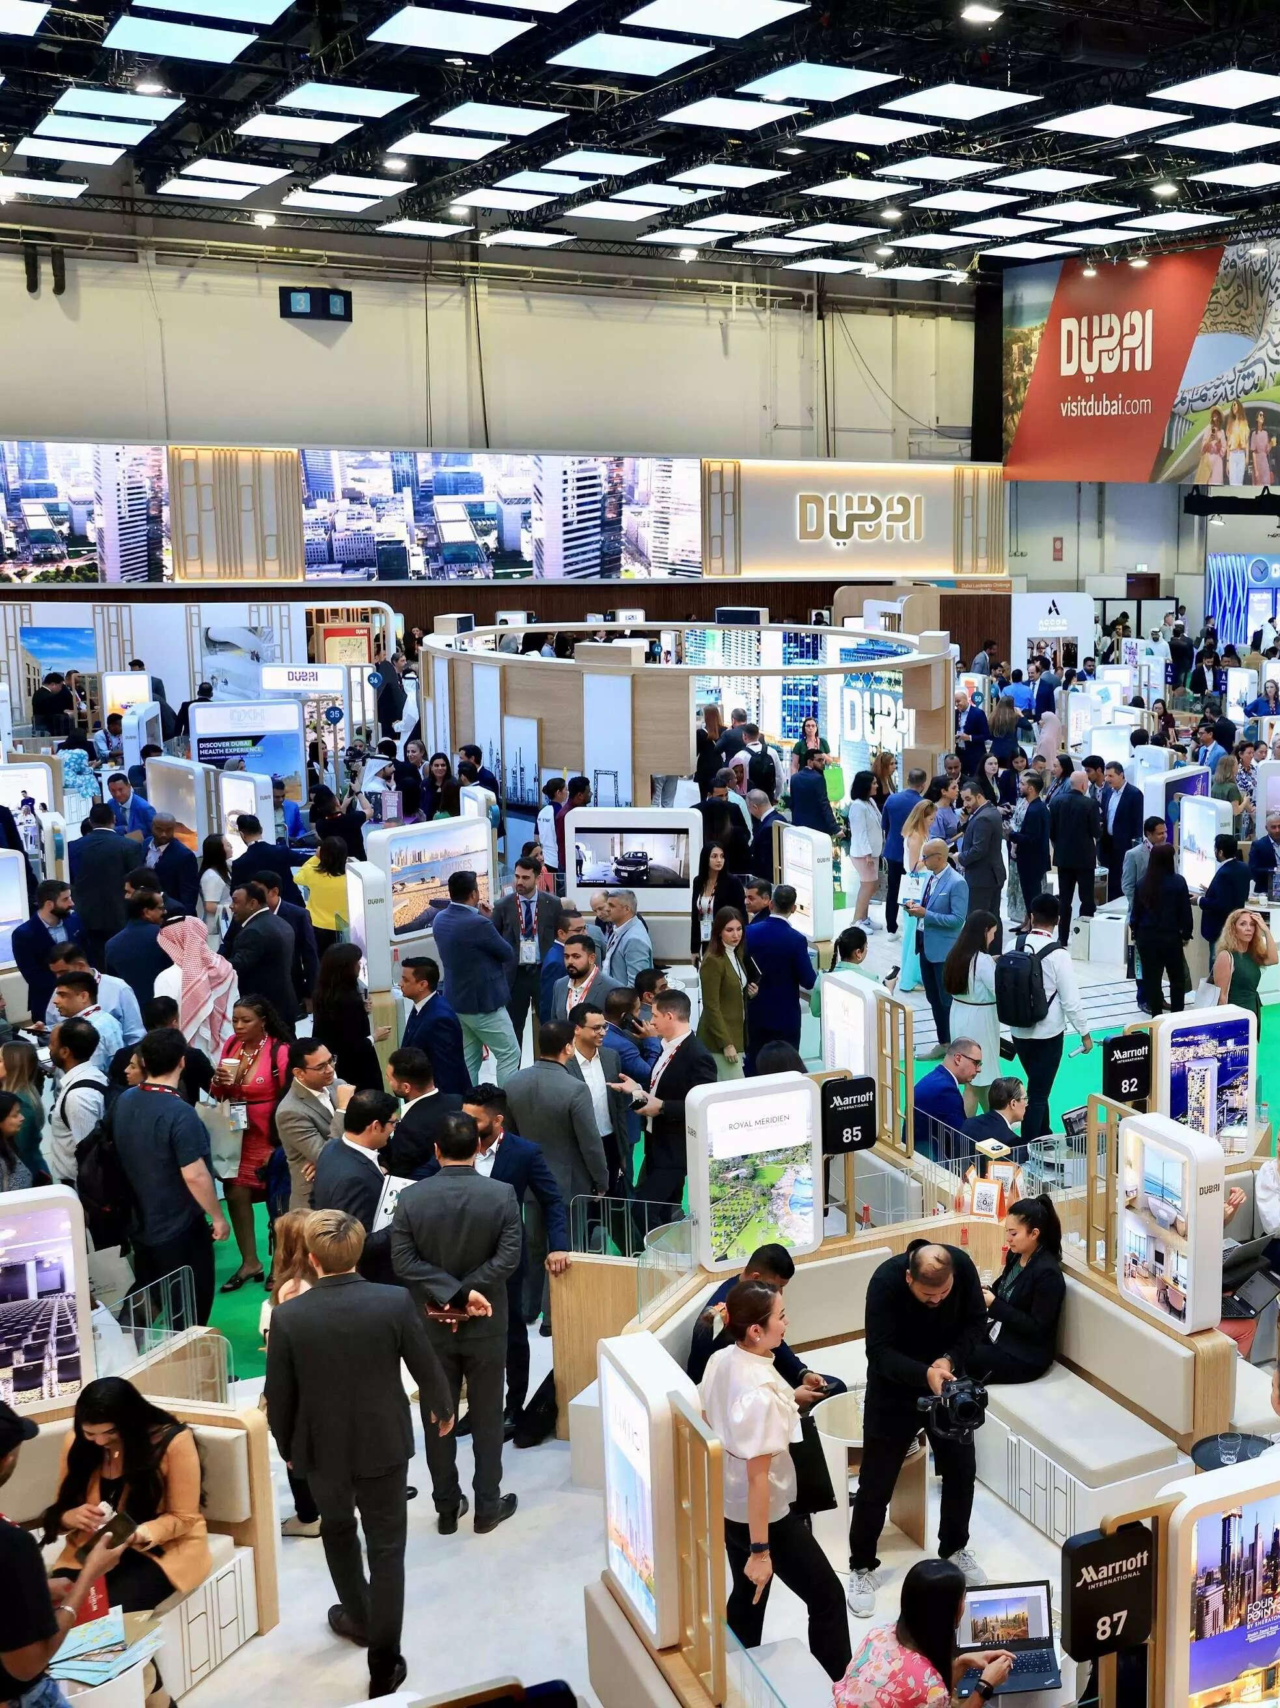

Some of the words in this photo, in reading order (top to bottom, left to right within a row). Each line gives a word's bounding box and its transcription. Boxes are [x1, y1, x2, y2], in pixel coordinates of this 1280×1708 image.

[1061, 309, 1153, 383] DUBAI
[1060, 395, 1152, 417] visitdubai.com
[798, 494, 923, 547] DUBAI
[288, 671, 318, 682] DUBAI
[370, 676, 379, 684] 36
[330, 711, 340, 719] 35
[224, 746, 262, 754] EXPERIENCE
[230, 739, 251, 747] DUBAI
[1111, 1046, 1149, 1062] Marriott
[1116, 1056, 1145, 1064] INTERNATIONAL
[1121, 1078, 1138, 1093] 82
[830, 1091, 874, 1108] Marriott
[836, 1102, 869, 1111] INTERNATIONAL
[728, 1120, 753, 1131] ROYAL
[842, 1126, 862, 1143] 85
[1198, 1183, 1221, 1196] DUBAI
[1075, 1549, 1149, 1588] Marriott
[1087, 1569, 1141, 1590] INTERNATIONAL
[1247, 1597, 1274, 1614] FOUR
[1095, 1610, 1129, 1640] 87
